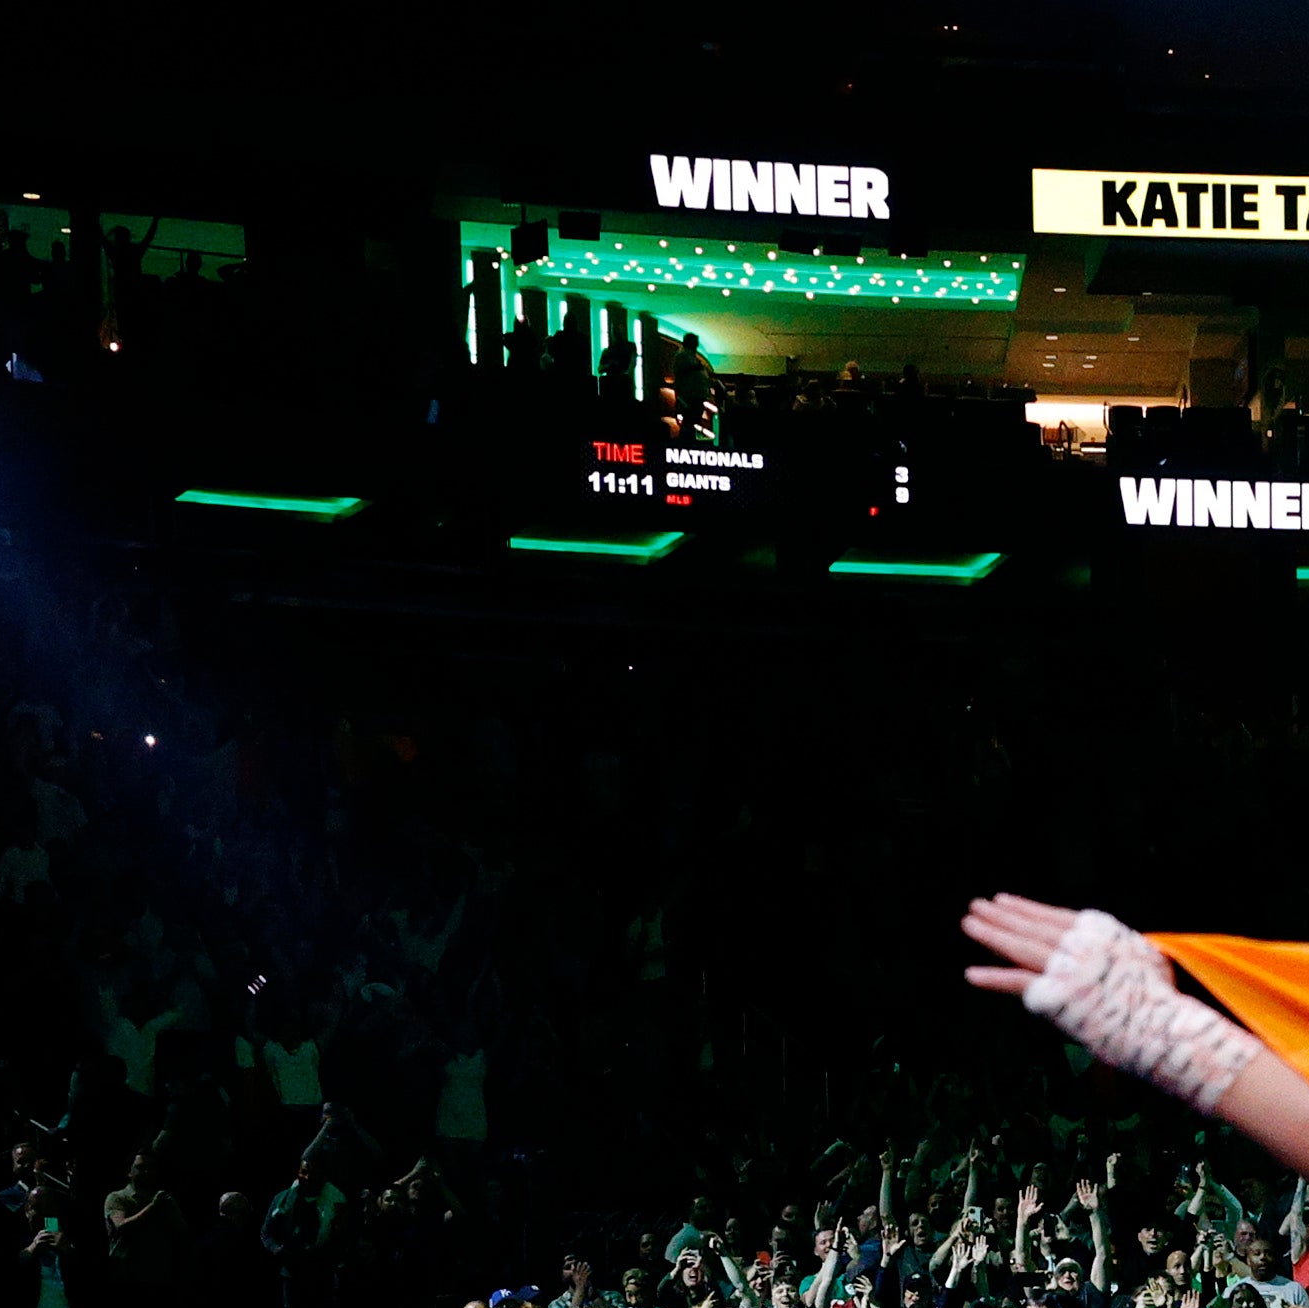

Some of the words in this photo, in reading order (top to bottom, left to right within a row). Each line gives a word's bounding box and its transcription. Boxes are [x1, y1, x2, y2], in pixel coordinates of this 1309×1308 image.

[648, 153, 891, 221] WINNER
[1101, 179, 1261, 231] KATIE
[592, 441, 645, 465] TIME
[665, 447, 765, 470] NATIONALS
[587, 470, 654, 496] 11:11
[665, 472, 732, 492] GIANTS
[894, 466, 910, 484] 3
